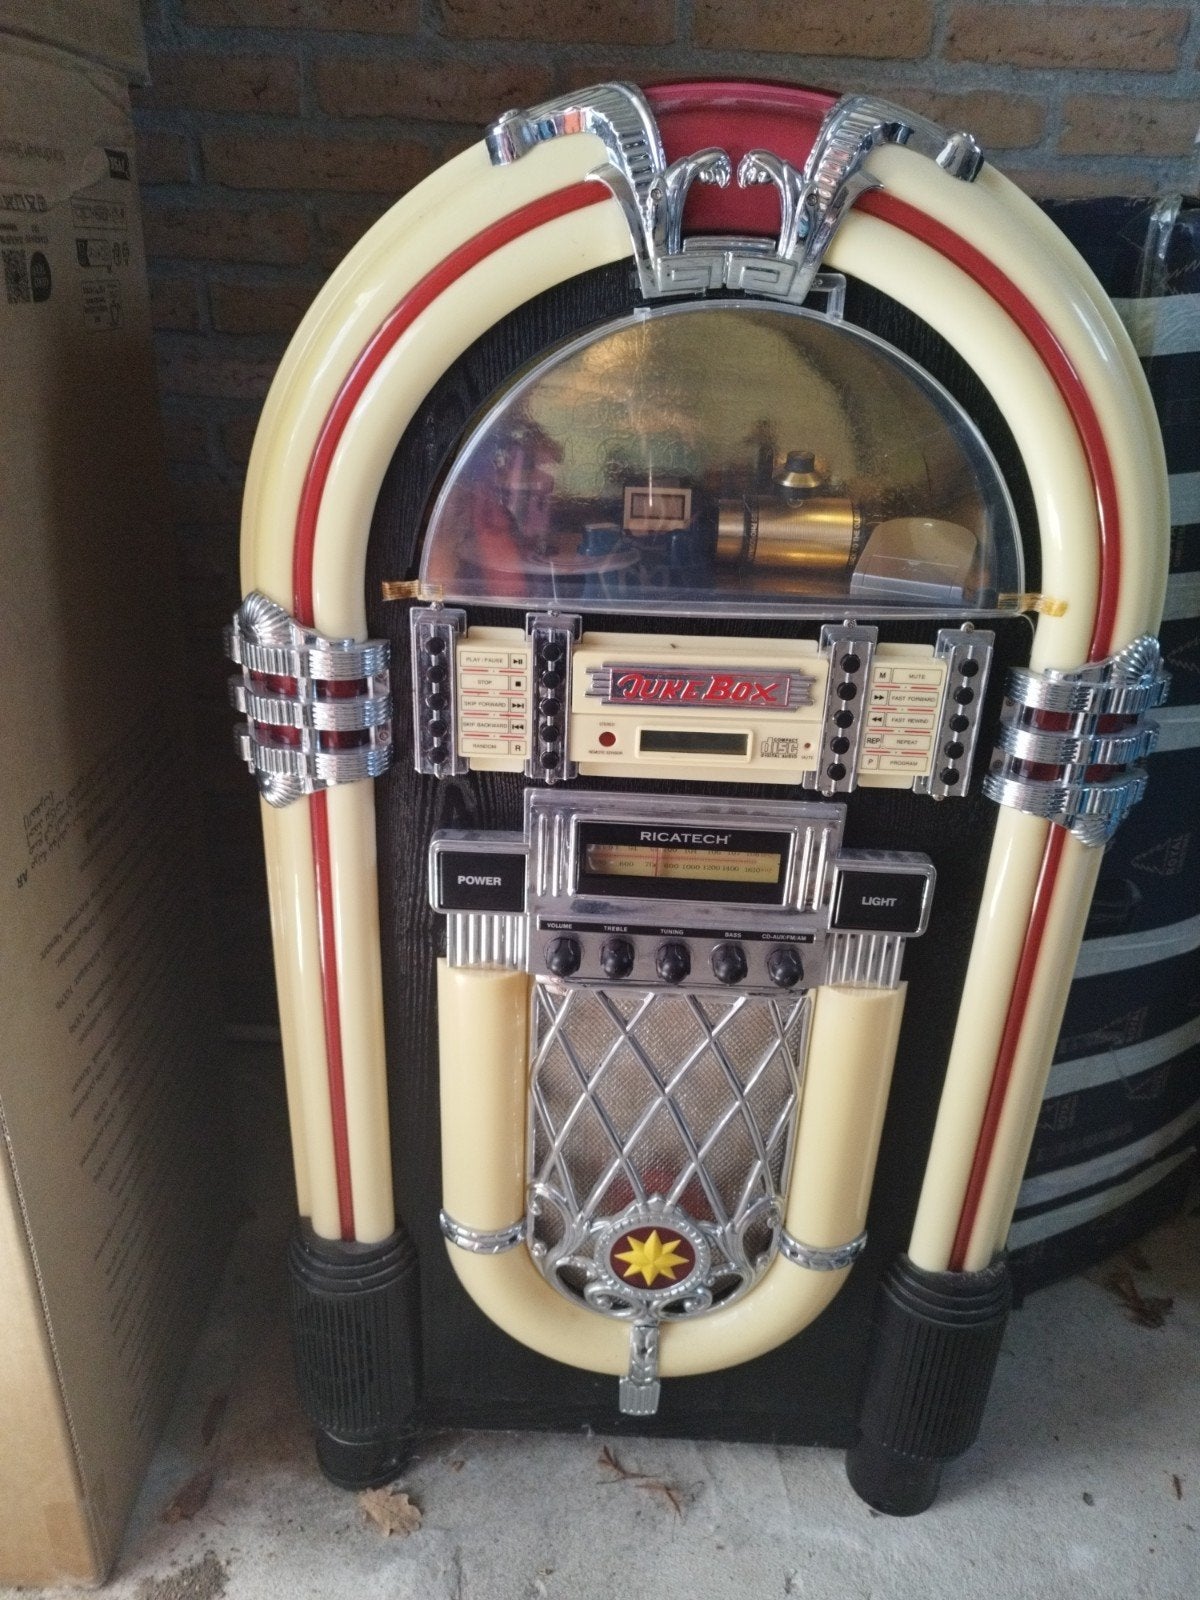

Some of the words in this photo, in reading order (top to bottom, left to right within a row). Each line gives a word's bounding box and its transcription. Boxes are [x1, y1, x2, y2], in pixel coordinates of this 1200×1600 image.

[702, 675, 780, 704] BOX
[640, 831, 729, 844] RICATECH
[458, 876, 502, 886] POWER
[862, 896, 898, 907] LIGHT
